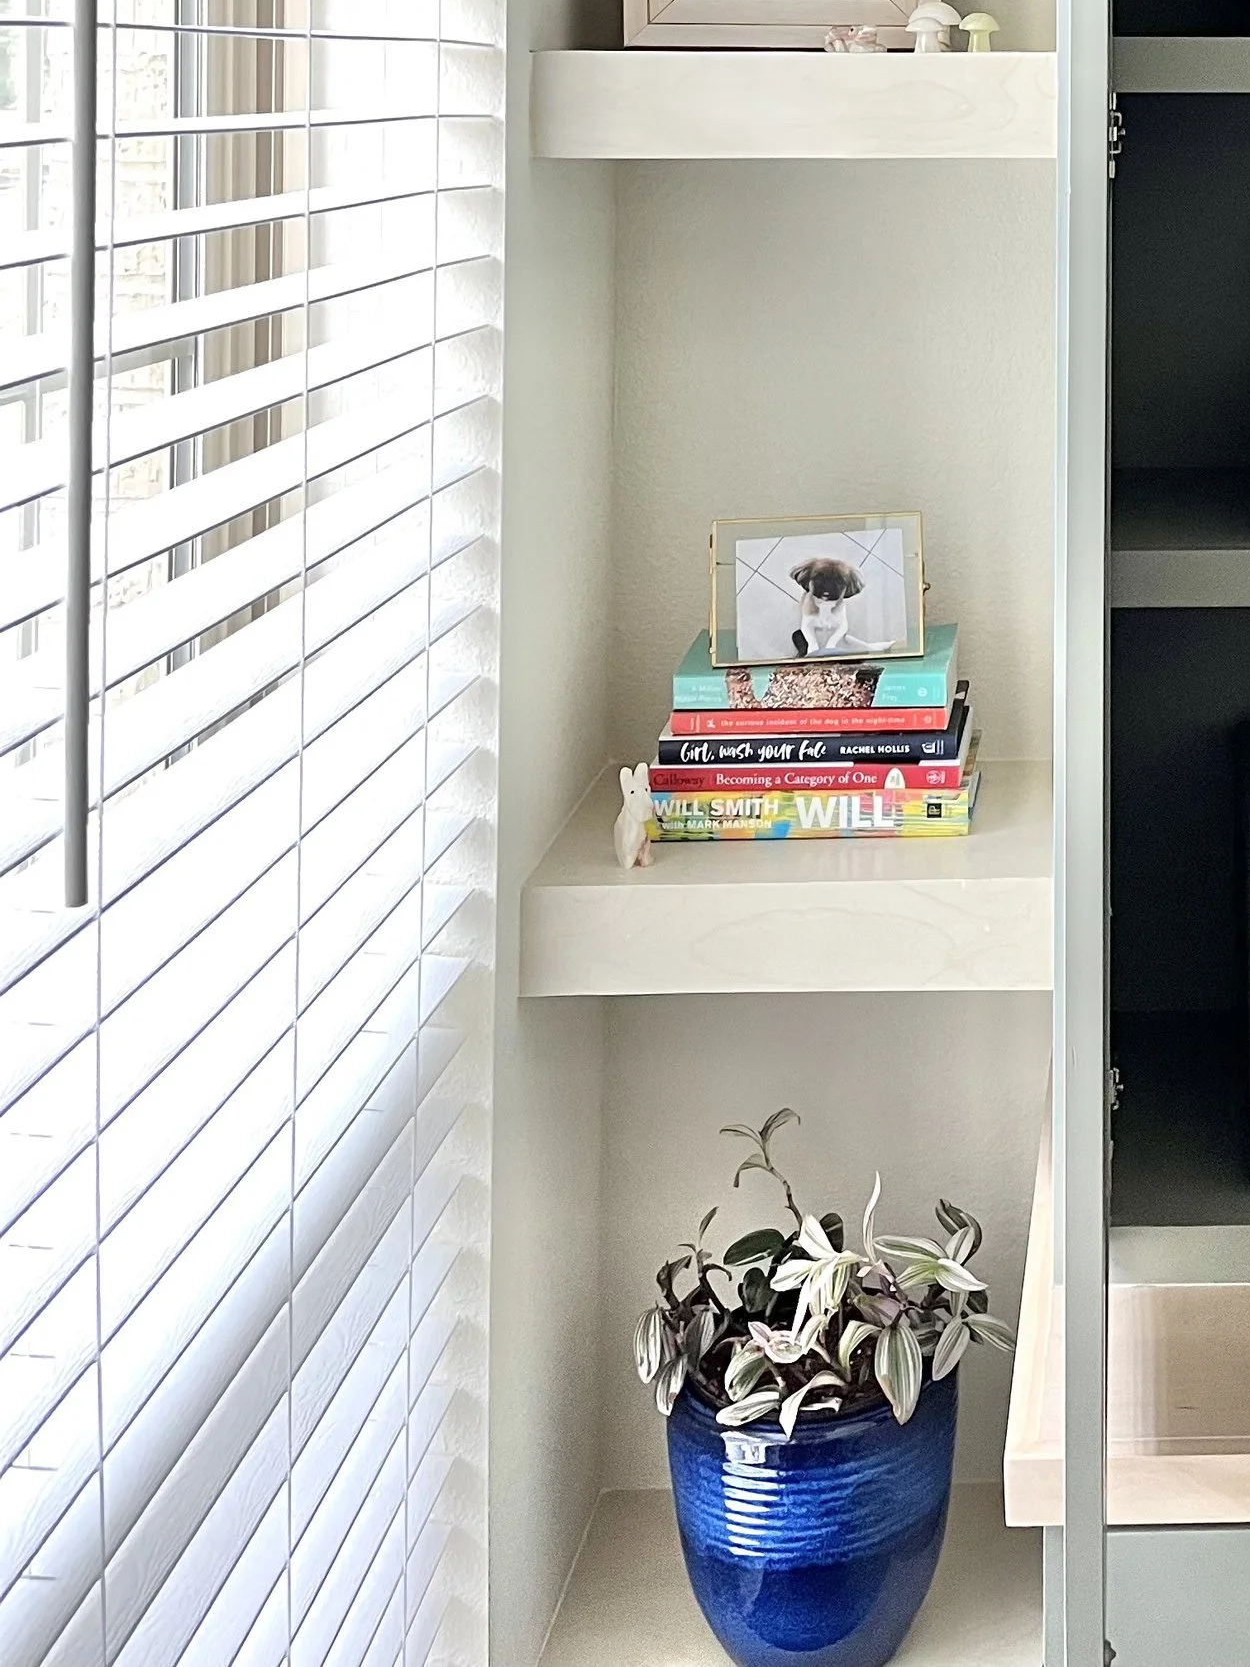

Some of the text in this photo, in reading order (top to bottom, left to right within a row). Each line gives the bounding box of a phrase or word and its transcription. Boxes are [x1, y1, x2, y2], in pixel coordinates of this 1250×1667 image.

[809, 717, 823, 725] the
[824, 717, 839, 727] dog
[841, 717, 850, 725] in
[851, 716, 864, 724] the
[719, 743, 753, 760] wash
[758, 744, 795, 762] your
[840, 744, 910, 755] RACHEL HOLLIS
[716, 773, 773, 787] Becoming
[774, 776, 781, 784] a
[784, 772, 834, 787] Category
[838, 771, 850, 783] of
[852, 771, 878, 783] One
[654, 796, 779, 816] WILL SMITH
[795, 795, 895, 829] WILL
[686, 819, 721, 829] MARK
[722, 818, 772, 829] MANSON
